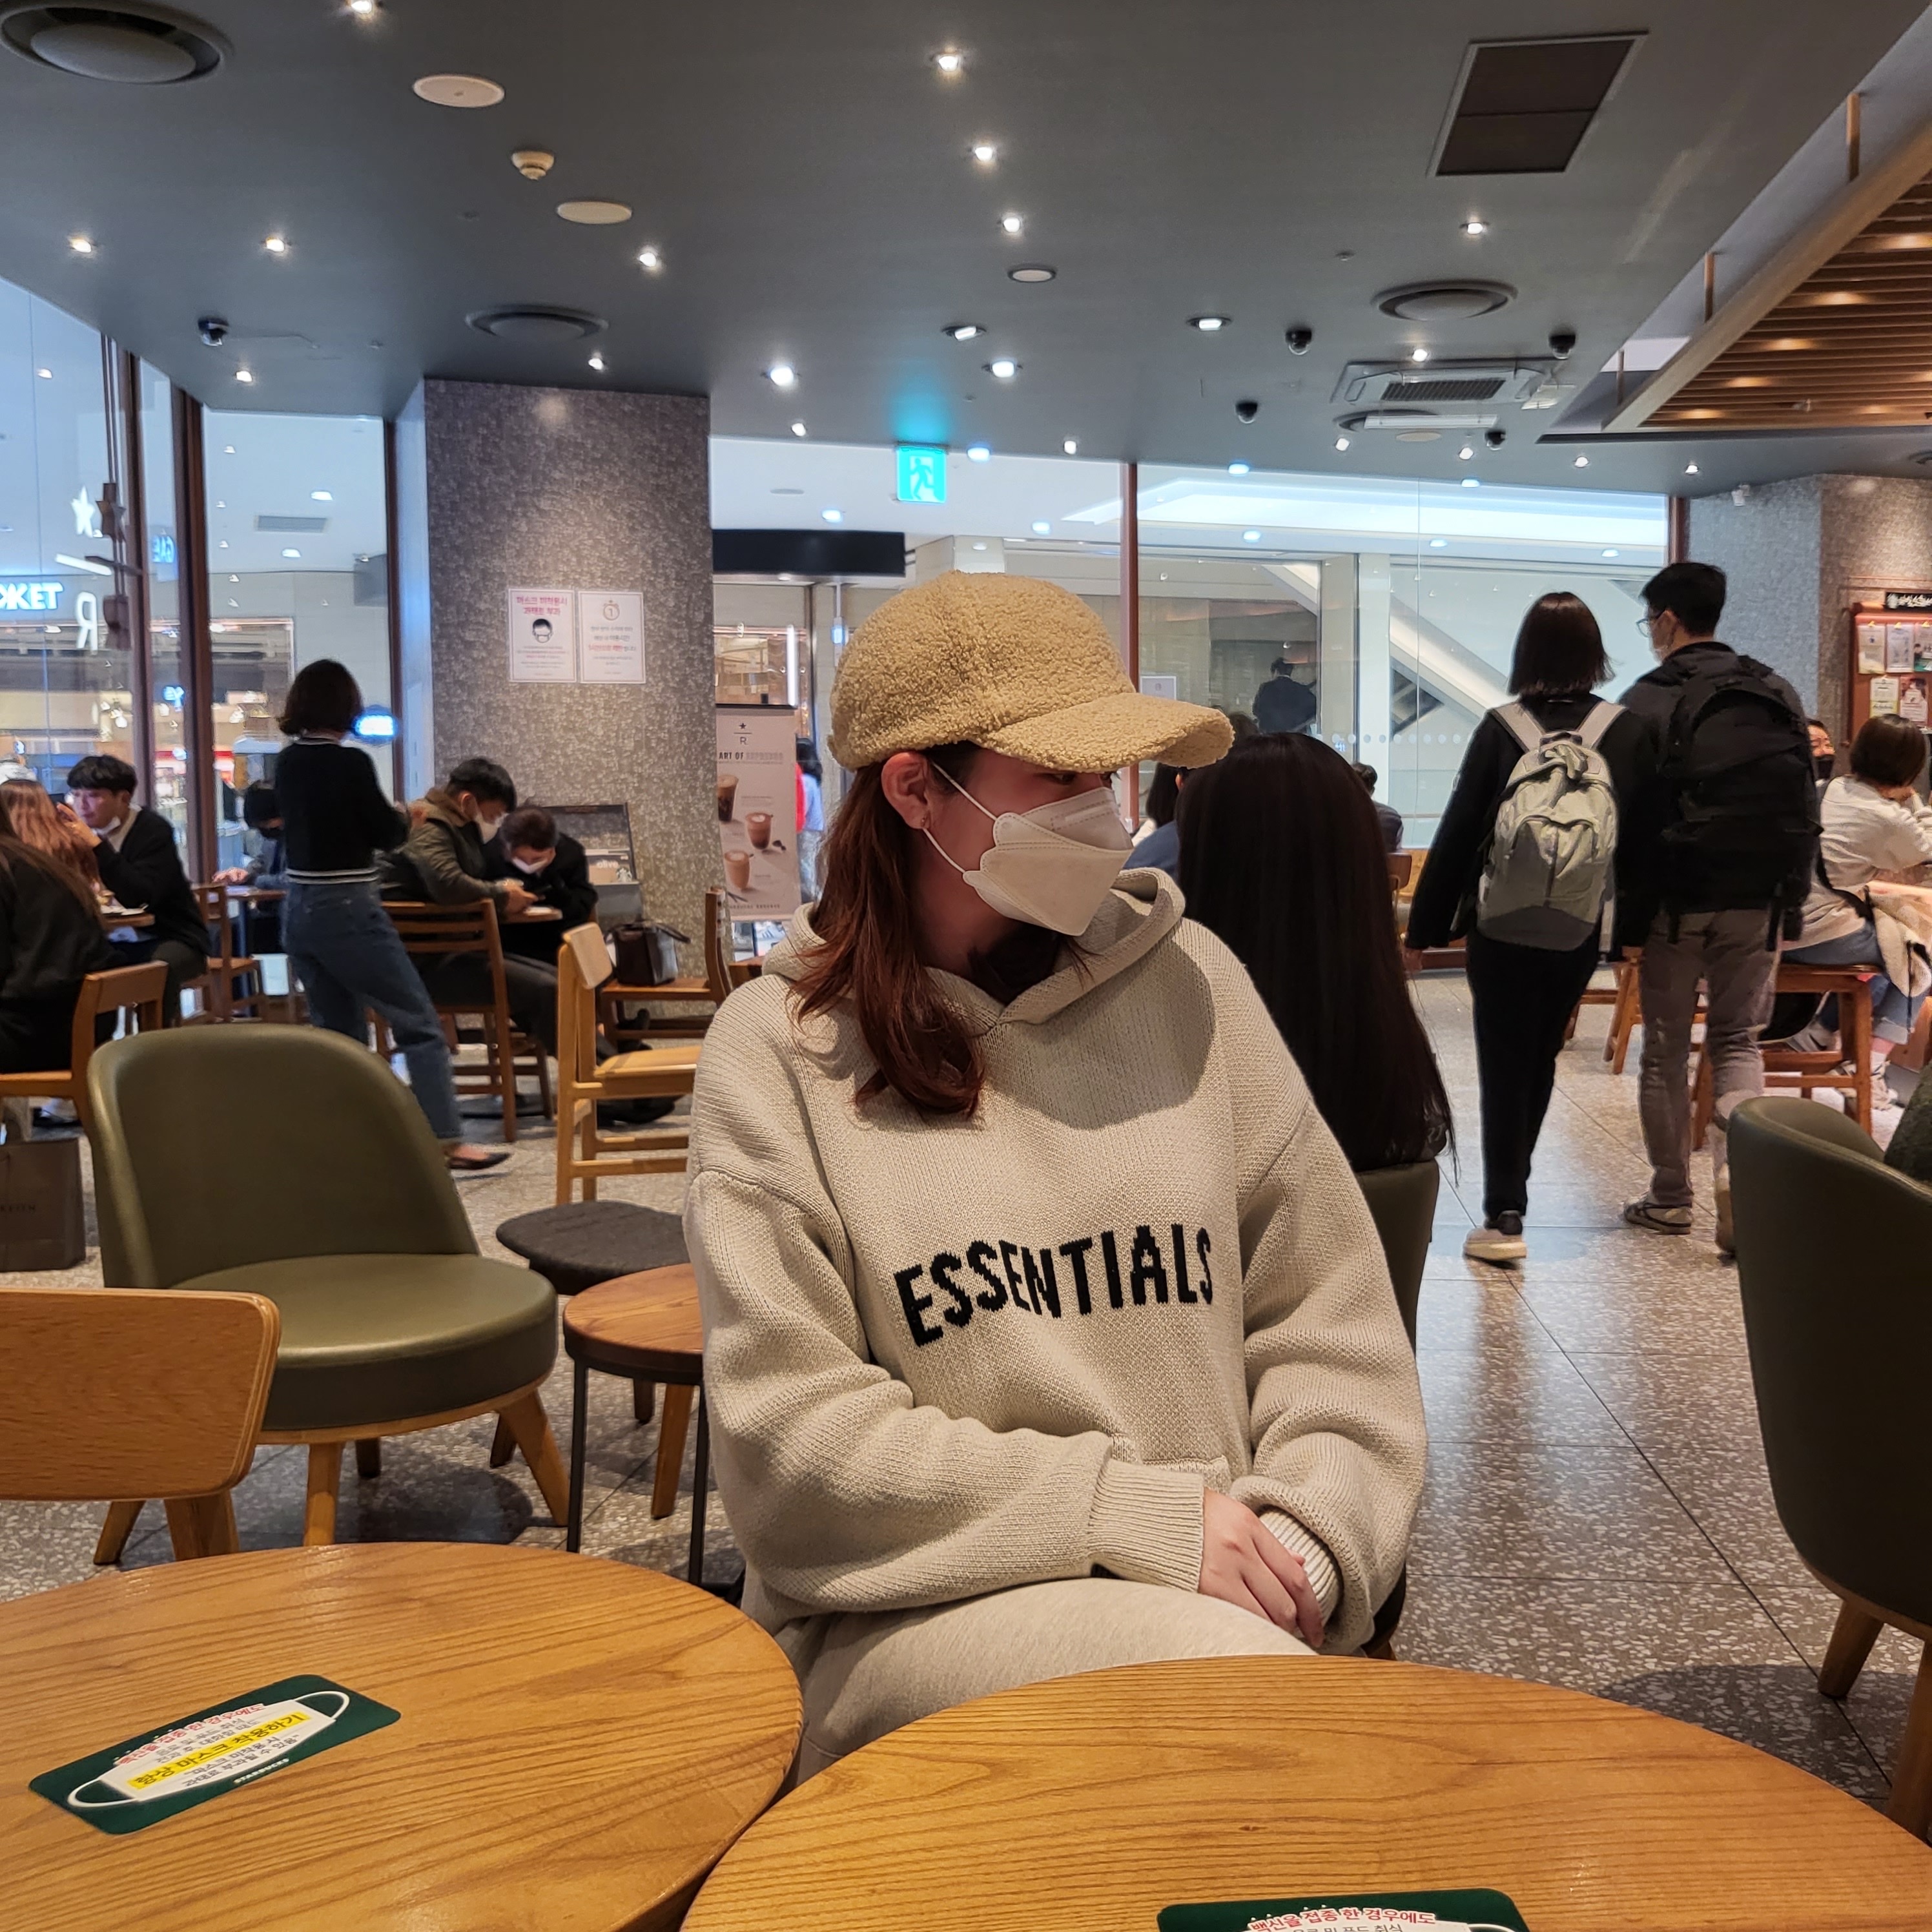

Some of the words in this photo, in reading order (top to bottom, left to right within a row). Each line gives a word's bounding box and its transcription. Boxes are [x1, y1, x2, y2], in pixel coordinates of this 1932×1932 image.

[740, 737, 748, 745] R
[893, 1224, 1212, 1347] ESSENTIALS
[208, 1706, 265, 1724] 경우에도
[220, 1718, 245, 1729] 취식
[199, 1730, 236, 1745] 대화할
[134, 1767, 175, 1784] 항상
[176, 1743, 233, 1767] 마스크
[232, 1714, 305, 1743] 착용하기
[229, 1743, 266, 1758] 미착용
[181, 1770, 223, 1786] 과태료
[222, 1753, 260, 1770] 부과될
[1251, 1915, 1302, 1932] 백신을
[1303, 1910, 1338, 1924] 접종
[1341, 1909, 1361, 1920] 한
[1365, 1909, 1435, 1924] 경우에도
